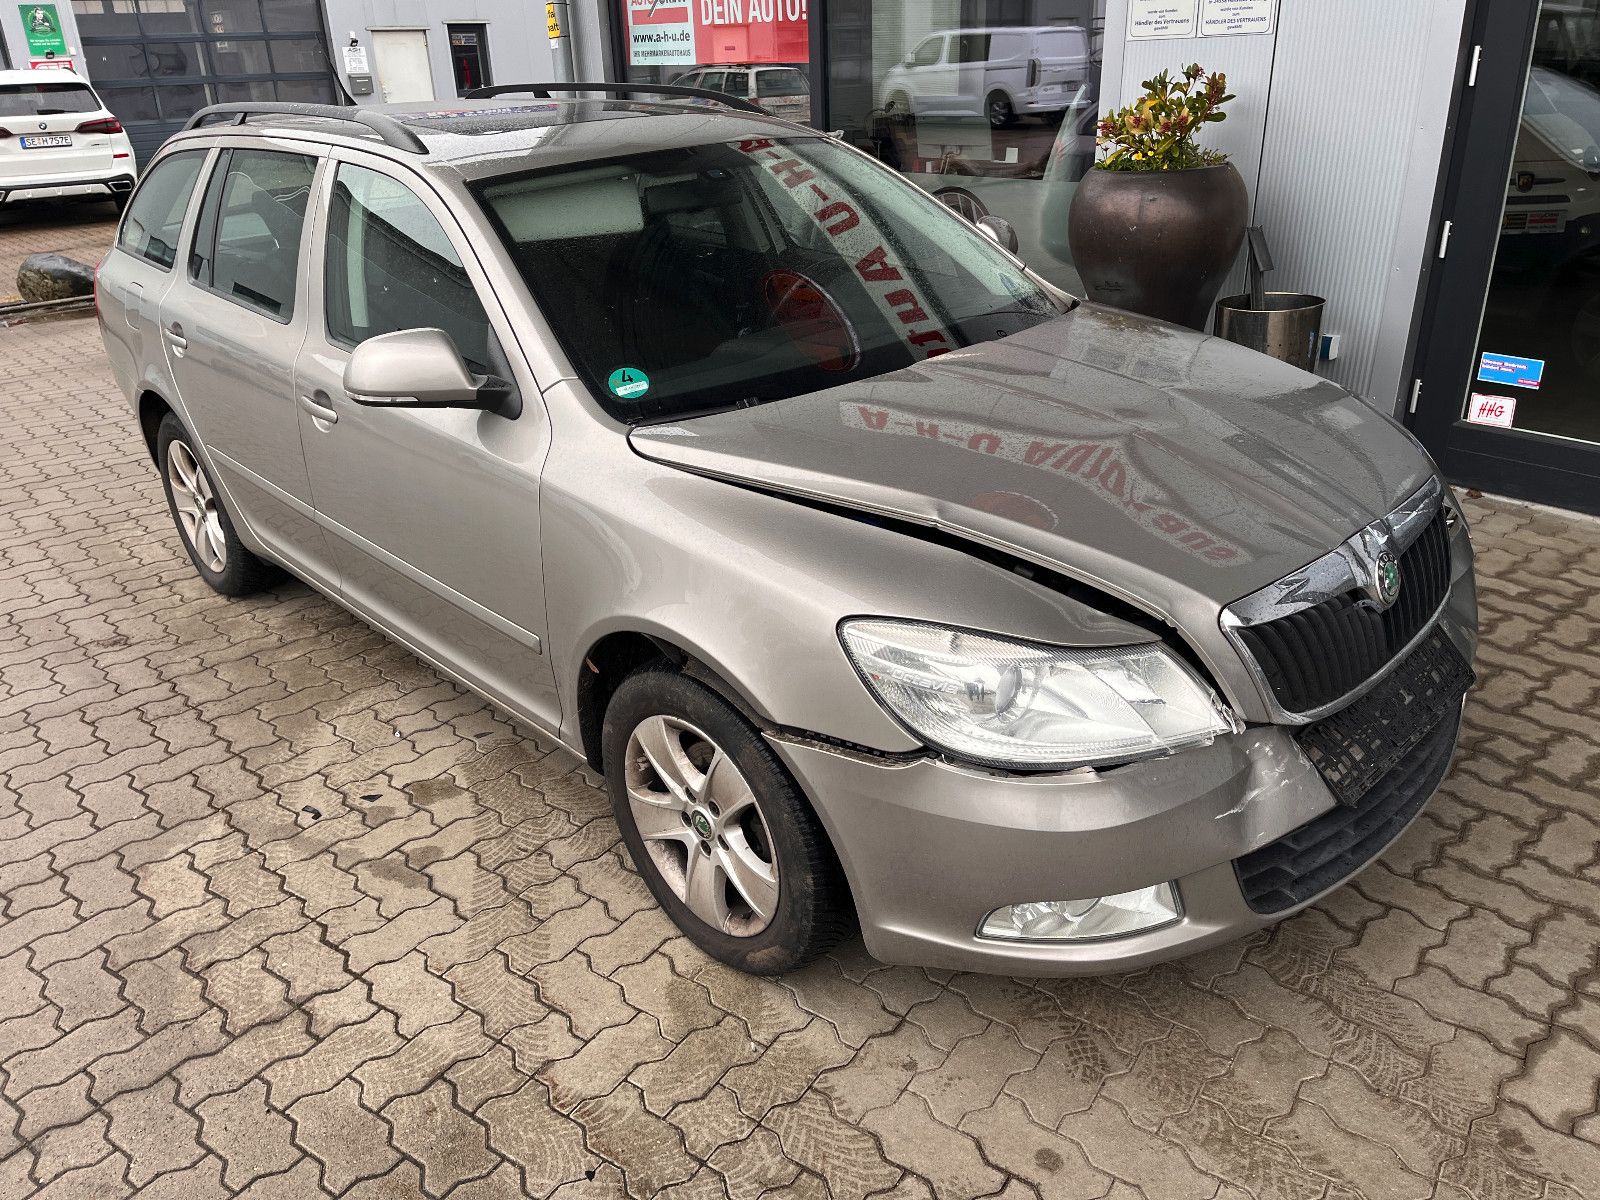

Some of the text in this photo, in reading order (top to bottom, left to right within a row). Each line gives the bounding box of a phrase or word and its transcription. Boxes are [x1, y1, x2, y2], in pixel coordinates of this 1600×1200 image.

[701, 0, 807, 25] DEIN AUTO!
[632, 30, 691, 43] www.a-h-u.de
[26, 138, 37, 146] SE
[622, 369, 634, 383] 4
